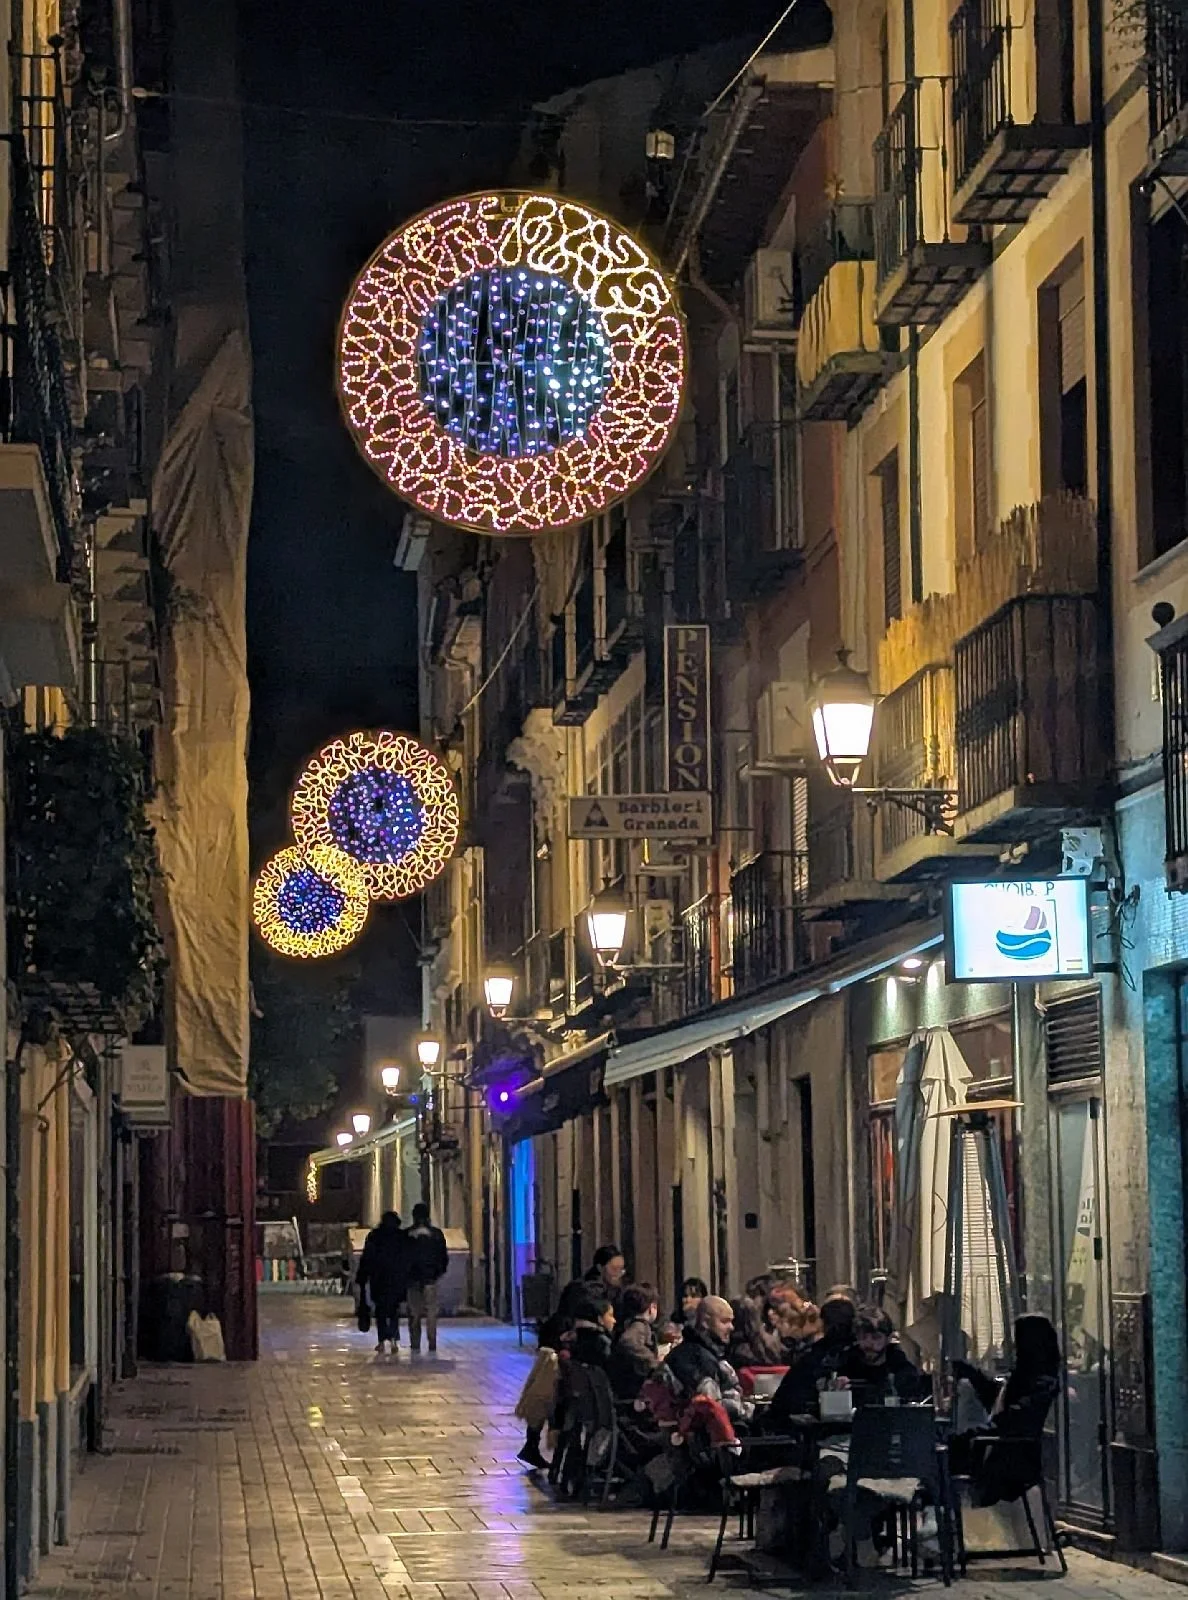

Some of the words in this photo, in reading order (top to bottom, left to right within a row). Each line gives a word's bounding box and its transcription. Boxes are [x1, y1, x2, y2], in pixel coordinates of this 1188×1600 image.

[674, 629, 703, 790] PENSION
[618, 799, 703, 815] Barbieri
[623, 816, 700, 831] Granada
